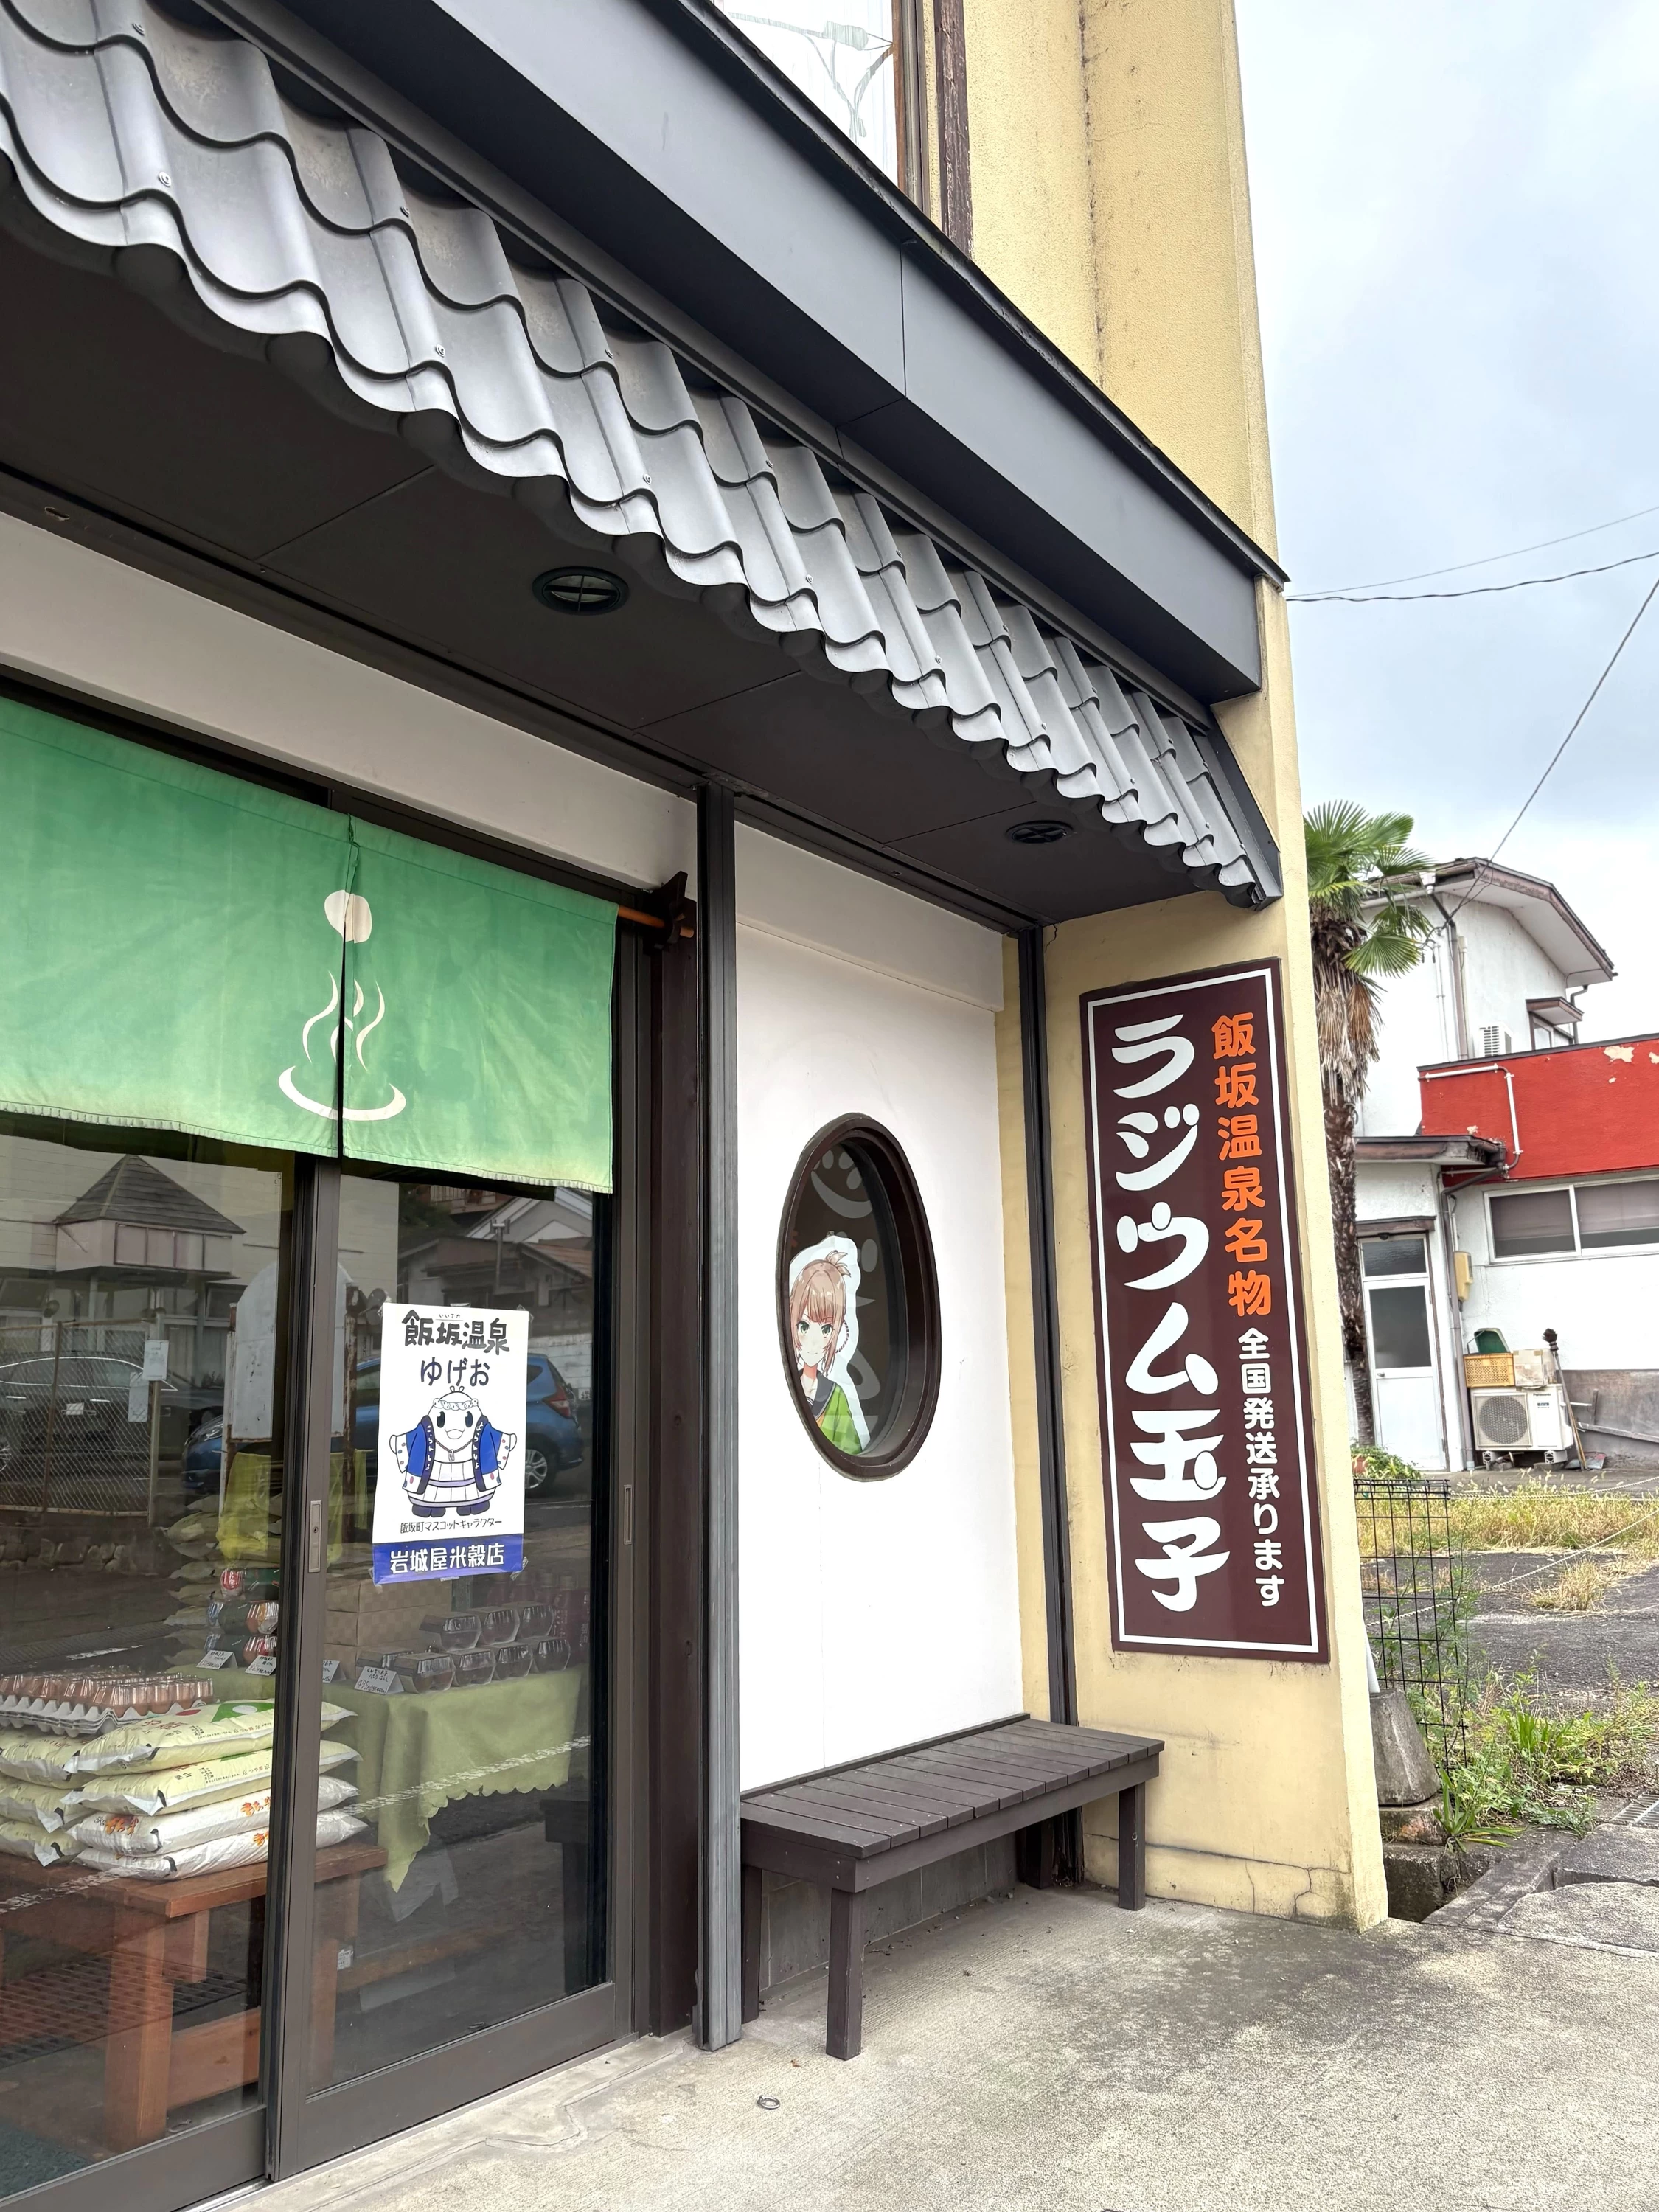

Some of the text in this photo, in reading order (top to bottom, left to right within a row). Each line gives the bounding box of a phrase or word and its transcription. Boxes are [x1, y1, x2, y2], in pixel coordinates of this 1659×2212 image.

[1111, 1014, 1231, 1612] ラジウム玉子
[1211, 1012, 1285, 1607] 飯坂温泉名物 全国発送承ります
[401, 1309, 510, 1355] 飯坂温泉
[420, 1357, 490, 1386] ゆげお
[400, 1518, 502, 1534] 飯坂町マスコットキャラクター
[389, 1543, 505, 1574] 岩城屋米穀店
